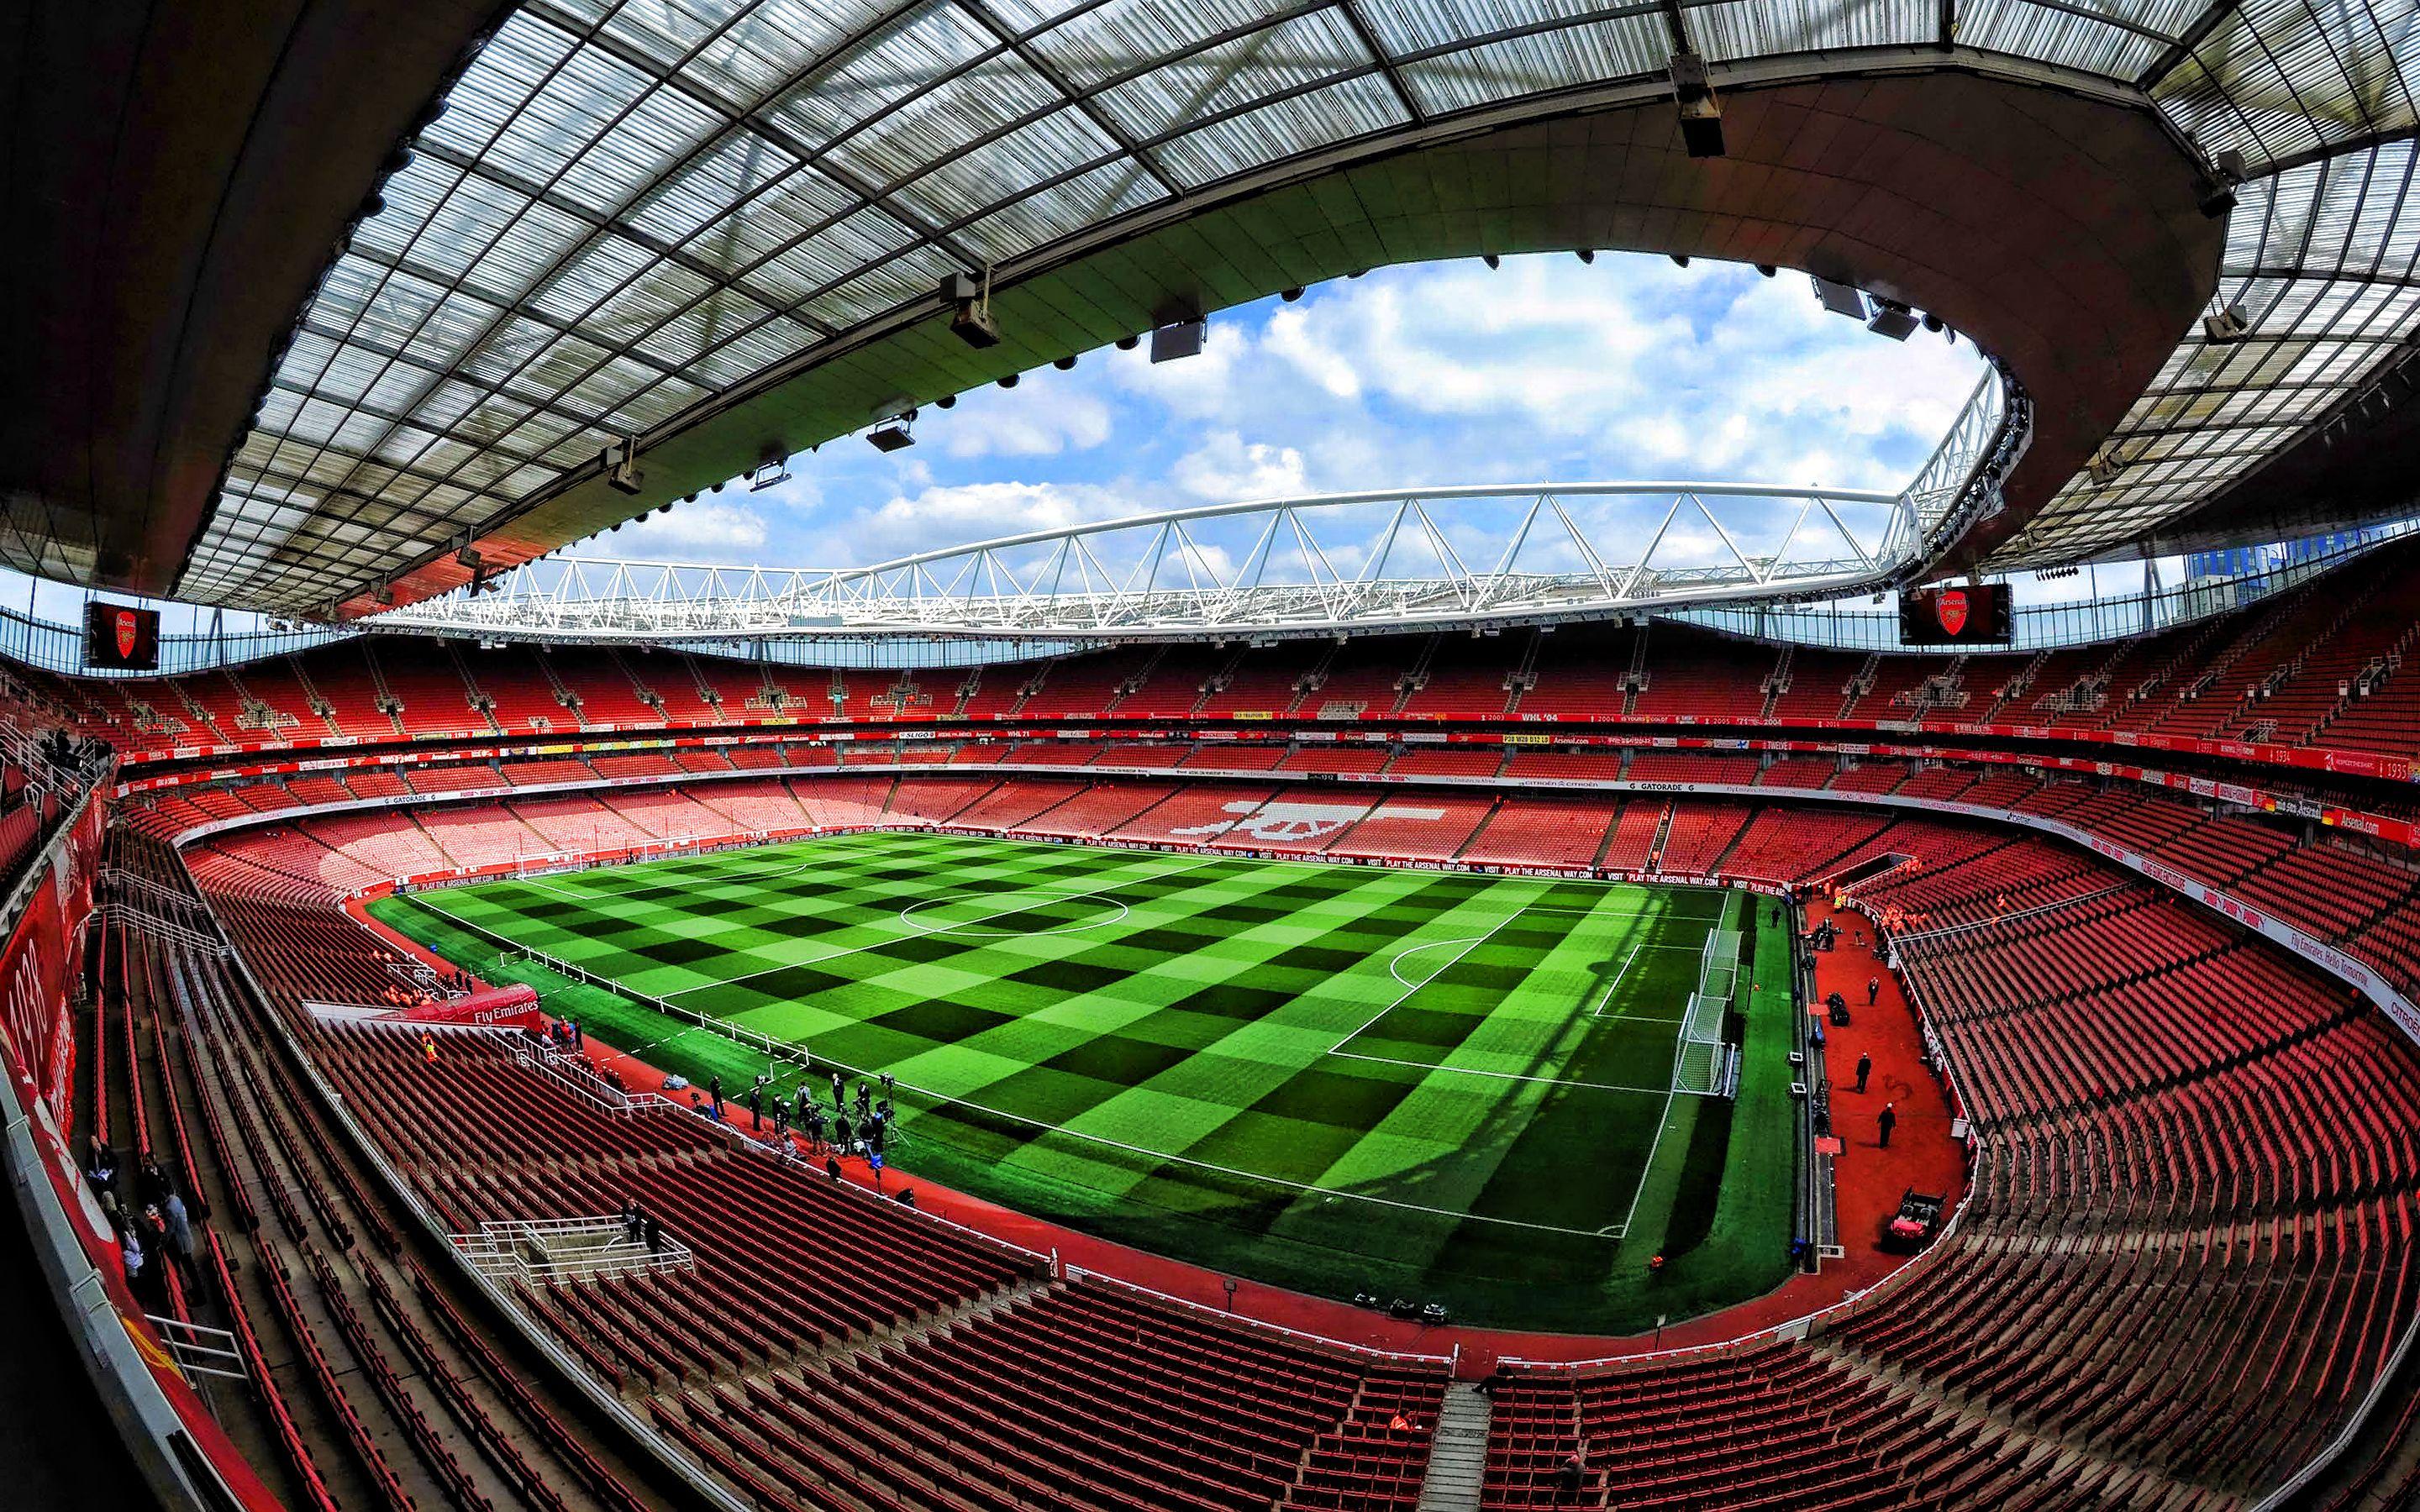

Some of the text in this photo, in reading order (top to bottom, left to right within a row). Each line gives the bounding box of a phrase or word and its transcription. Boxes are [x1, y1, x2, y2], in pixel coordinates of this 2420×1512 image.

[1522, 713, 1541, 722] WHL
[1553, 736, 1589, 745] Arsenal.com
[1815, 743, 1838, 752] Arsenal
[2386, 762, 2407, 780] 1935
[1641, 783, 1682, 791] GATORADE
[393, 795, 427, 803] GATORADE
[2340, 811, 2380, 836] Arsenal.com
[1302, 854, 1327, 863] ARSENAL
[1414, 862, 1441, 870] ARSENAL
[1522, 867, 1534, 875] THE
[1534, 869, 1562, 877] ARSENAL
[1564, 870, 1592, 879] WAY.COM
[1607, 873, 1623, 881] VISIT
[1646, 874, 1659, 883] THE
[1660, 875, 1688, 885] ARSENAL
[1690, 876, 1718, 887] WAY.COM
[1733, 880, 1748, 889] VISIT
[1765, 885, 1776, 895] THE
[2291, 933, 2300, 951] Fly
[2326, 950, 2339, 969] Hello
[474, 1000, 539, 1025] Fly Emirates
